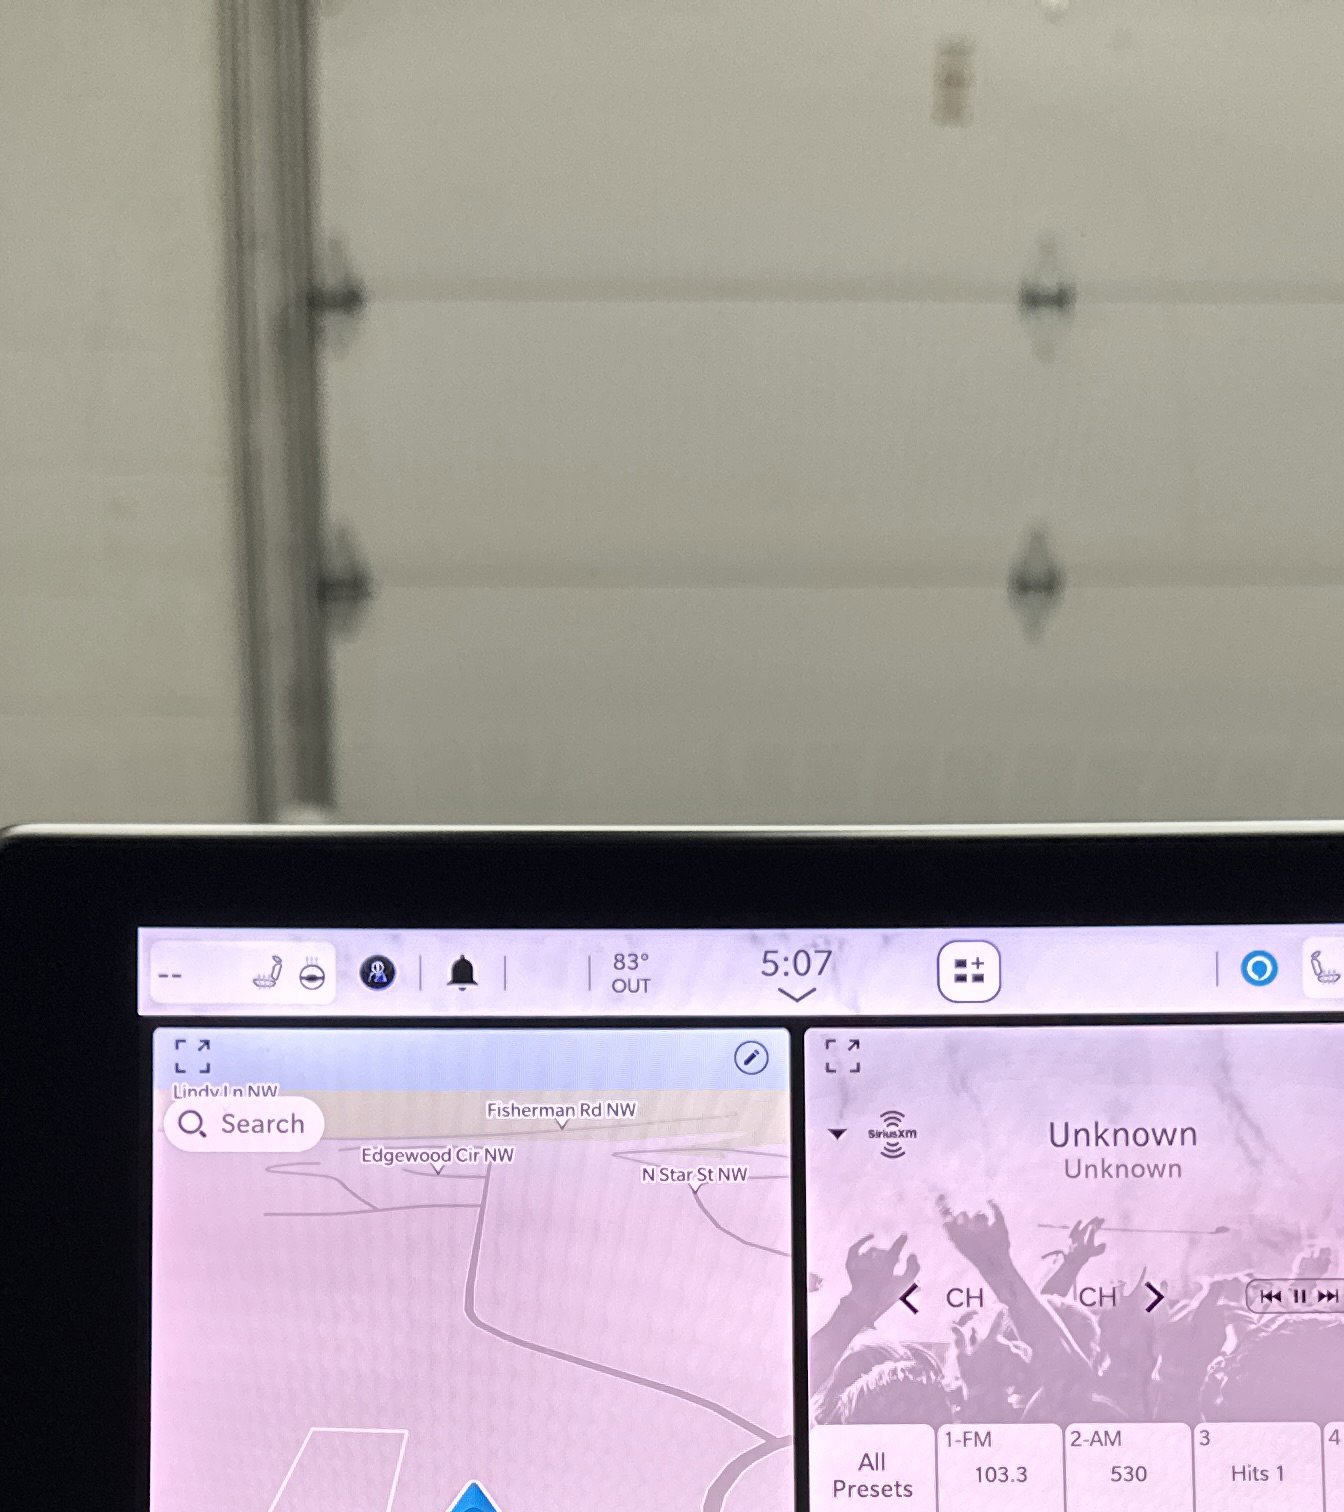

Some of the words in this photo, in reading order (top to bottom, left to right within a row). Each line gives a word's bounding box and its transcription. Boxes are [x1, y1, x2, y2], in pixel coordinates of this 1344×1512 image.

[613, 952, 650, 971] 83°
[761, 948, 833, 977] 5:07
[611, 977, 651, 994] OUT
[486, 1100, 577, 1118] Fisherman
[580, 1102, 602, 1118] Rd
[606, 1101, 637, 1117] NW
[221, 1112, 305, 1134] Search
[1049, 1121, 1197, 1148] Unknown
[361, 1147, 452, 1169] Edgewood
[455, 1146, 480, 1164] Cir
[484, 1147, 514, 1164] NW
[642, 1167, 655, 1182] N
[659, 1167, 693, 1182] Star
[696, 1167, 714, 1182] St
[717, 1167, 748, 1182] NW
[1064, 1157, 1182, 1180] Unknown
[946, 1287, 984, 1309] CH
[1078, 1286, 1117, 1308] CH
[945, 1430, 992, 1448] 1-FM
[1070, 1429, 1122, 1448] 2-AM
[1199, 1429, 1211, 1447] 3
[1328, 1428, 1341, 1446] 4
[857, 1451, 886, 1472] All
[976, 1465, 1028, 1484] 103.3
[1110, 1465, 1148, 1483] 530
[1231, 1464, 1270, 1482] Hits
[1276, 1464, 1284, 1482] 1
[833, 1479, 913, 1499] Presets
